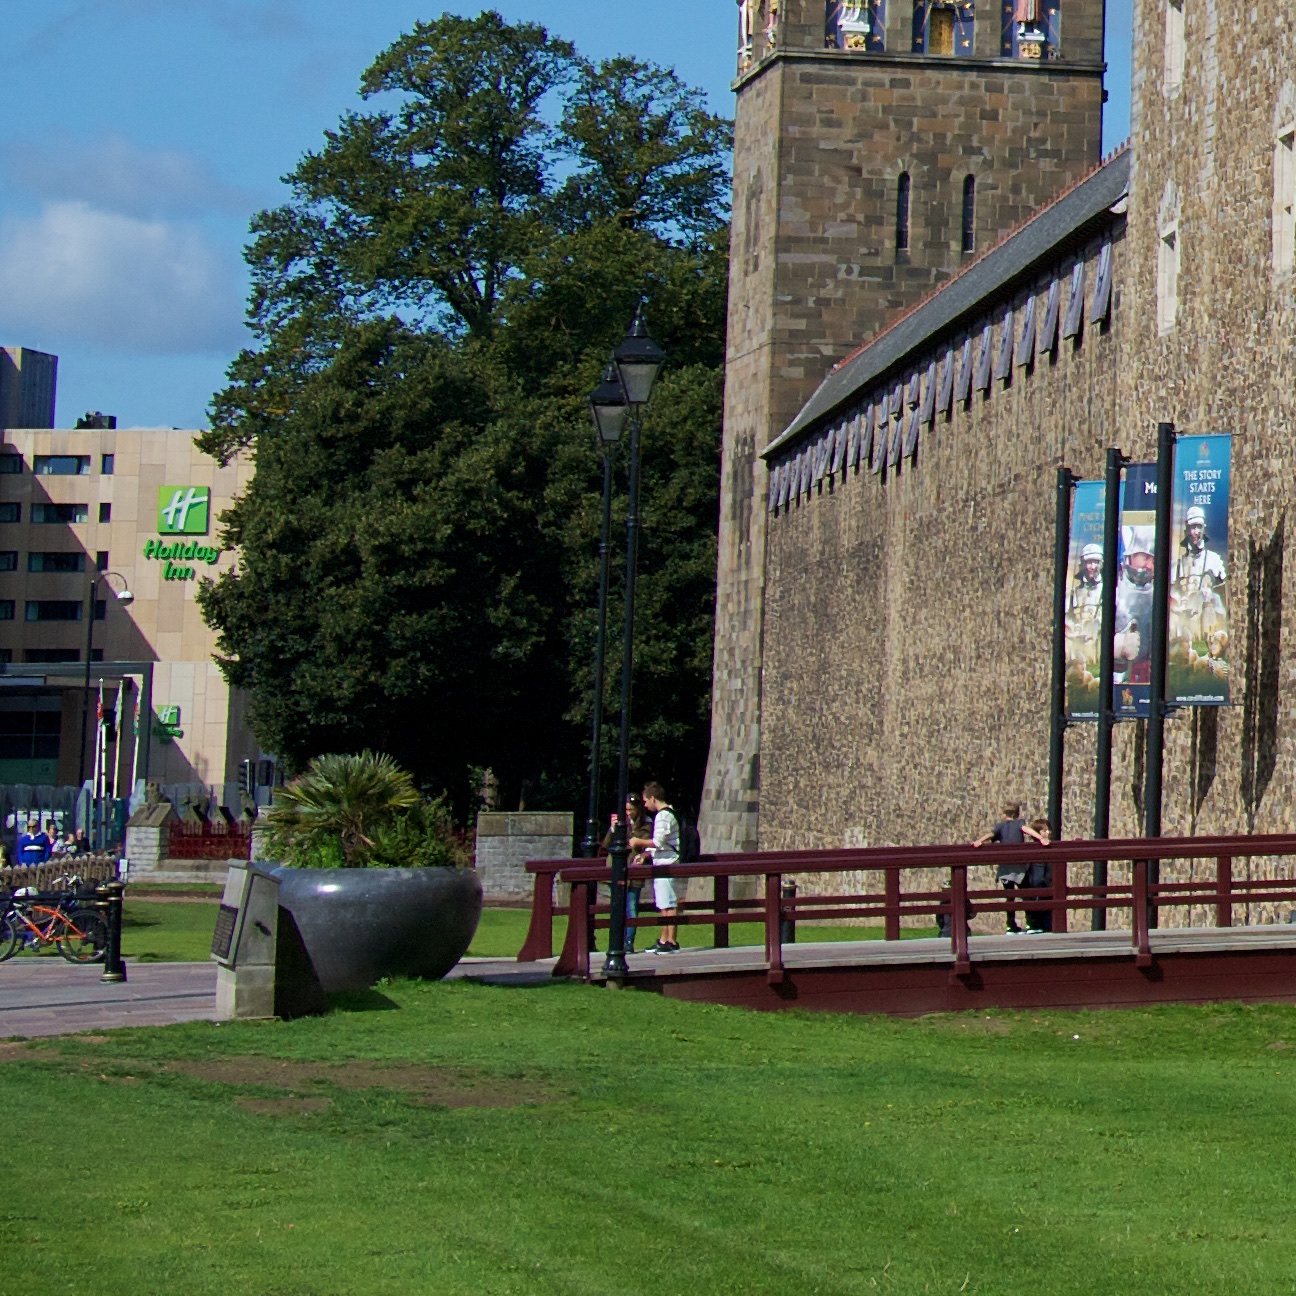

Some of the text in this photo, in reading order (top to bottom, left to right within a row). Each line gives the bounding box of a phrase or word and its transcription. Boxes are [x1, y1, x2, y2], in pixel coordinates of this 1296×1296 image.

[1183, 469, 1222, 481] THE STORY
[1189, 482, 1216, 493] STARTS
[1193, 494, 1212, 505] HERE
[143, 539, 219, 564] Holiday
[163, 560, 194, 580] Inn
